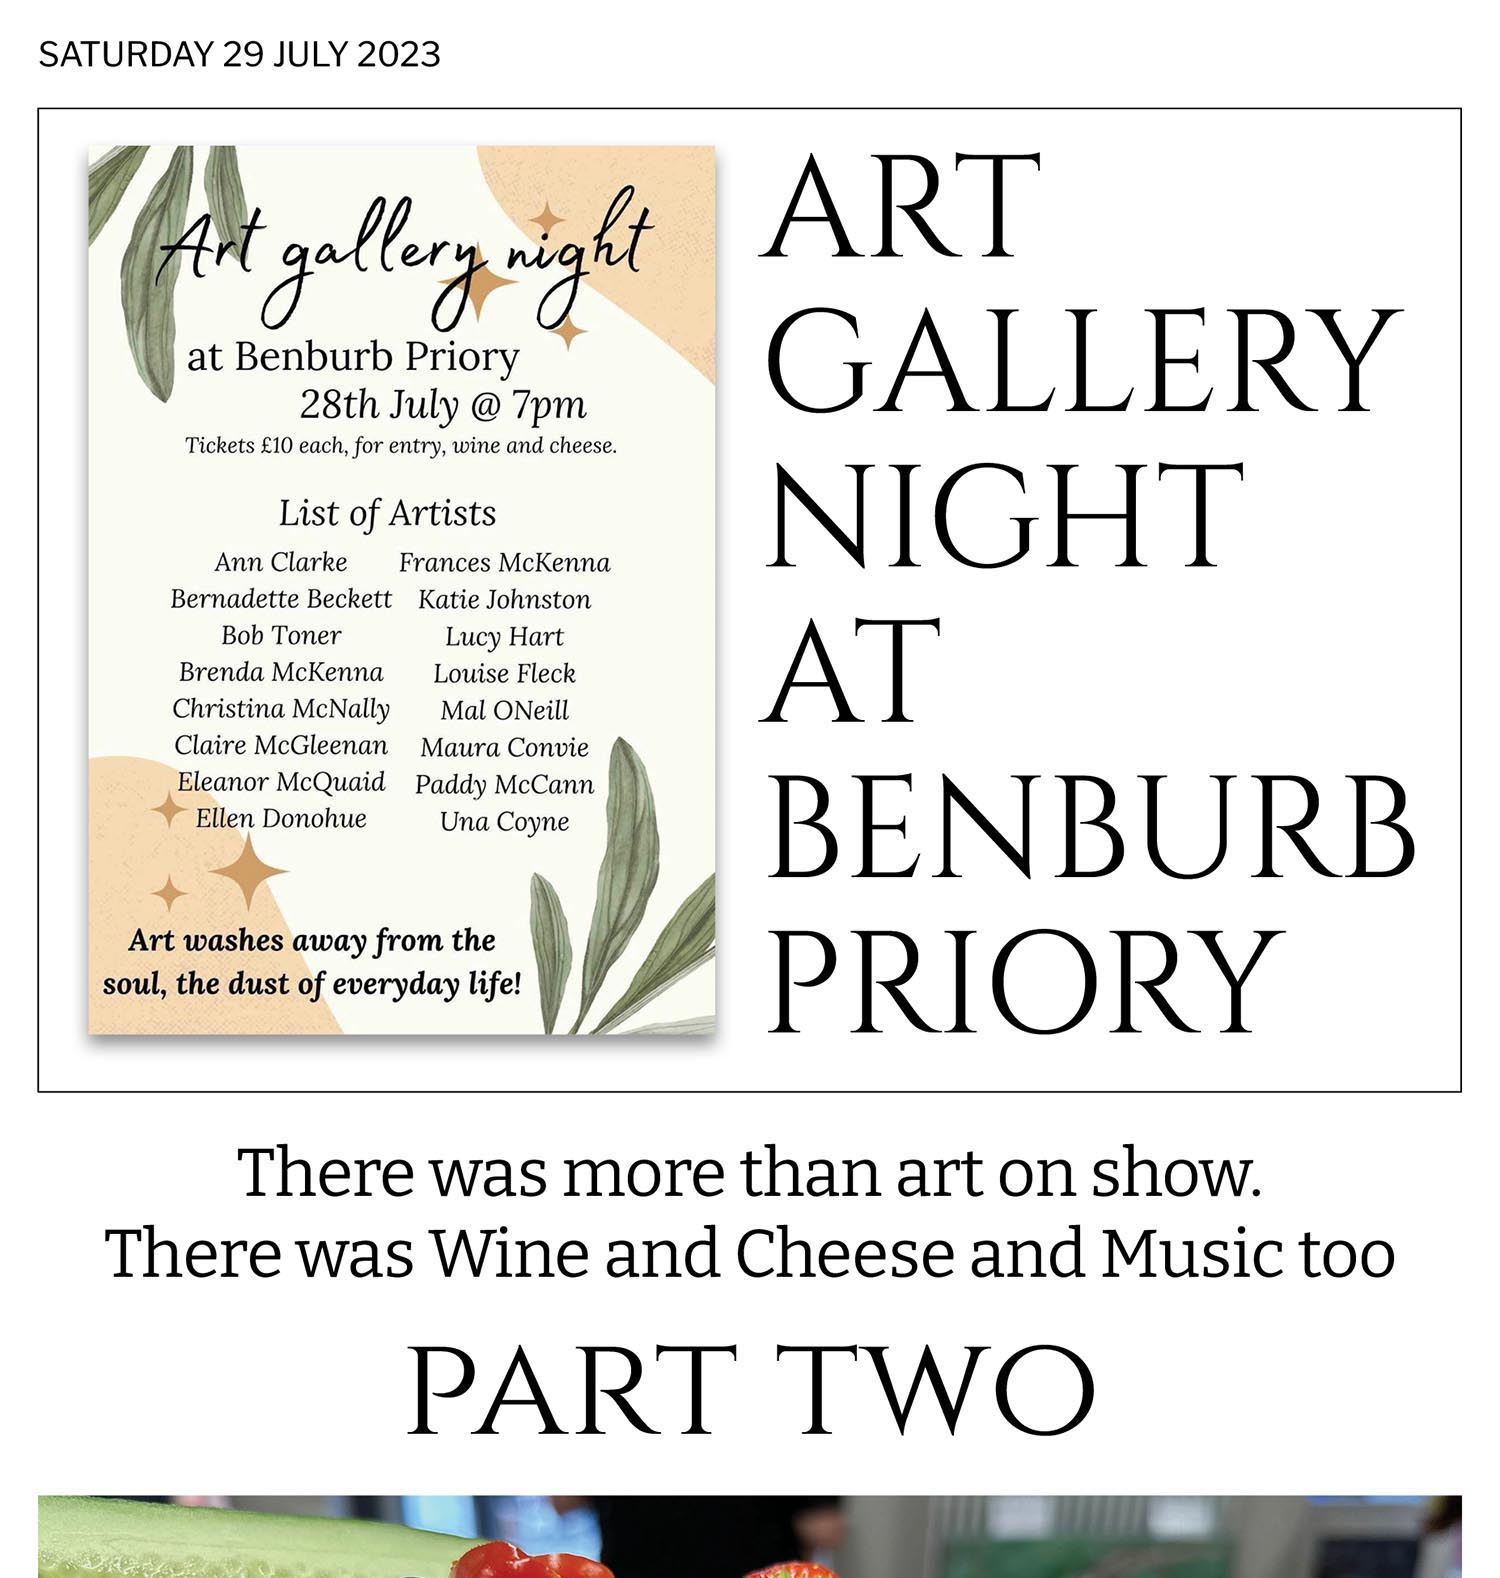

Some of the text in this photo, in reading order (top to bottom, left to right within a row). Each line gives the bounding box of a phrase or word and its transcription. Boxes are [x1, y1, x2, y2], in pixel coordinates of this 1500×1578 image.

[155, 184, 656, 333] Art gallery night
[188, 339, 520, 381] at Benburb Priory
[301, 388, 587, 428] 28th July @ 7pm
[186, 436, 616, 459] Tickets £10 each, for entry, wine and cheese.
[280, 498, 495, 535] List of Artists
[215, 551, 347, 572] Ann Clarke
[400, 553, 612, 572] Frances McKenna
[171, 588, 392, 608] Bernadette Beckett
[419, 589, 591, 609] Katie Johnston
[222, 624, 342, 645] Bob Toner
[447, 627, 564, 653] Lucy Hart
[180, 661, 384, 681] Brenda McKenna
[435, 663, 576, 683] Louise Fleck
[173, 698, 389, 724] Christina McNally
[441, 700, 569, 720] Mal ONeill
[175, 734, 388, 755] Claire McGleenan
[421, 737, 588, 757] Maura Convie
[179, 771, 385, 797] Eleanor McQuaid
[416, 774, 594, 800] Paddy McCann
[197, 807, 366, 828] Ellen Donohue
[441, 811, 568, 838] Una Coyne
[128, 927, 495, 959] Art washes away from the
[104, 971, 520, 1002] soul, the dust of everyday life!
